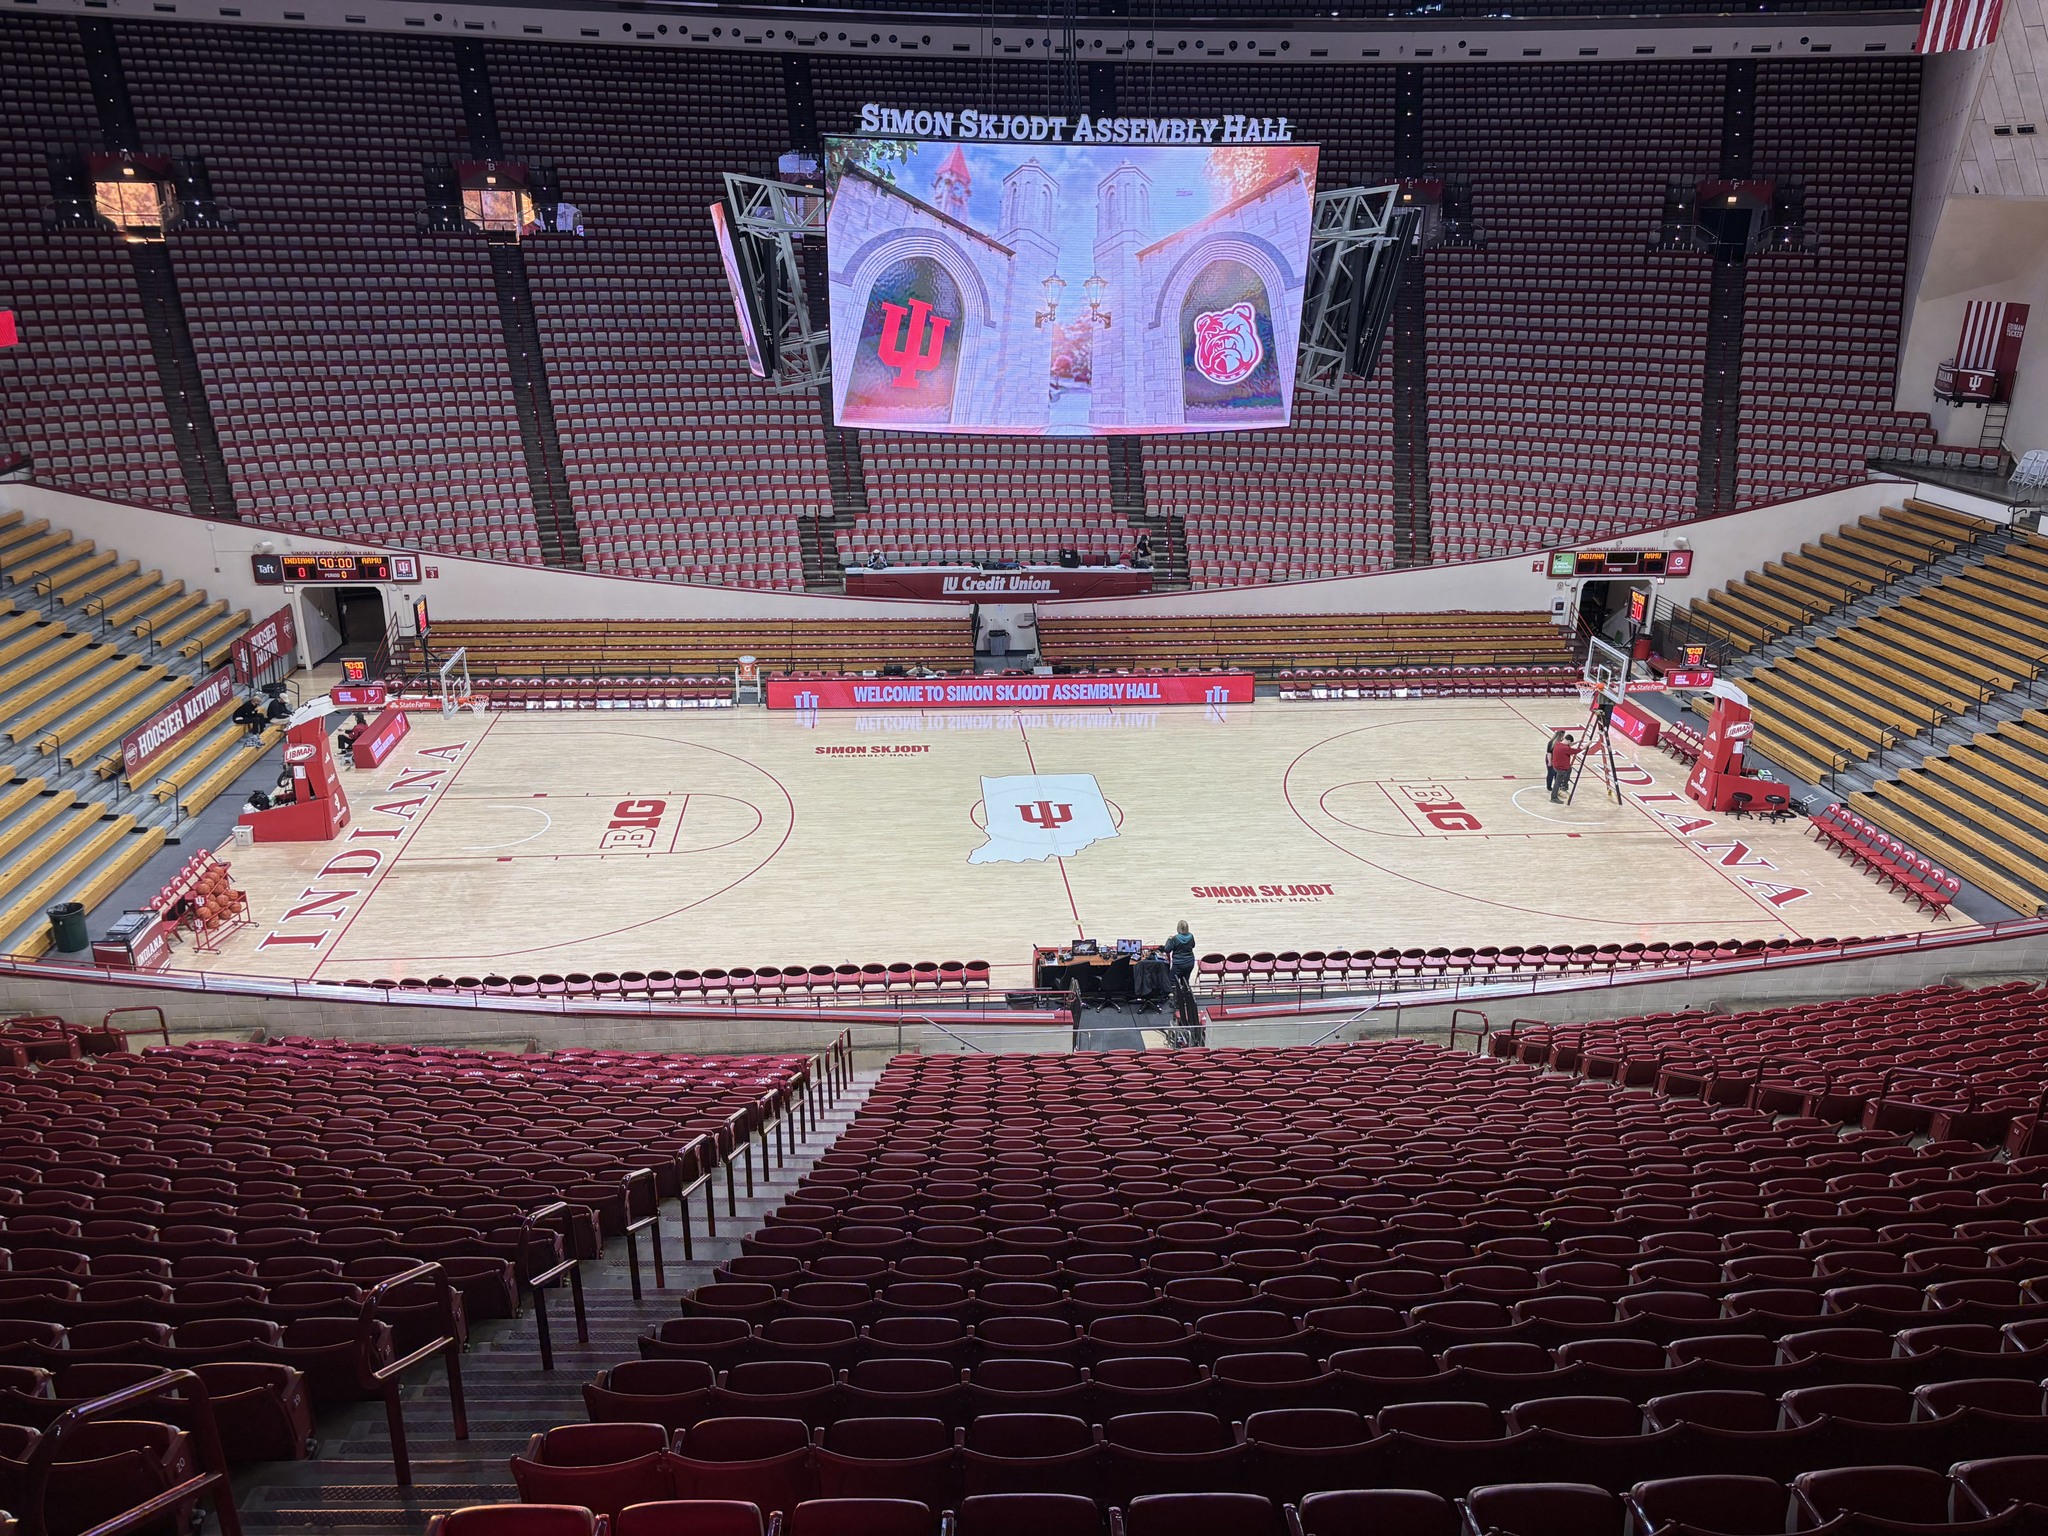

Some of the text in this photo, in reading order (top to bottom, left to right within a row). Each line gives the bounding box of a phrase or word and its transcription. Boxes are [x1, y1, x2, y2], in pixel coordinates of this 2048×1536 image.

[861, 103, 1293, 144] SIMON SKJODT ASSEMBLY HALL
[488, 163, 495, 171] B
[1407, 181, 1413, 189] E
[1733, 182, 1740, 190] F
[284, 557, 316, 565] INDIANA
[319, 557, 353, 568] 90:00
[257, 565, 275, 574] Taft
[298, 567, 306, 577] 0
[379, 567, 386, 577] 0
[943, 575, 1051, 590] IU Credit Union
[1631, 603, 1643, 621] 30
[1687, 655, 1699, 664] 30
[350, 670, 363, 679] 30
[853, 683, 1161, 702] WELCOME TO SIMON SKJODT ASSEMBLY HALL
[138, 681, 221, 759] HOOSIER NATION
[285, 746, 313, 762] LIBMAN
[815, 745, 931, 755] SIMON SKJODT
[255, 740, 471, 952] INDIANA
[1190, 884, 1335, 898] SIMON SKJODT
